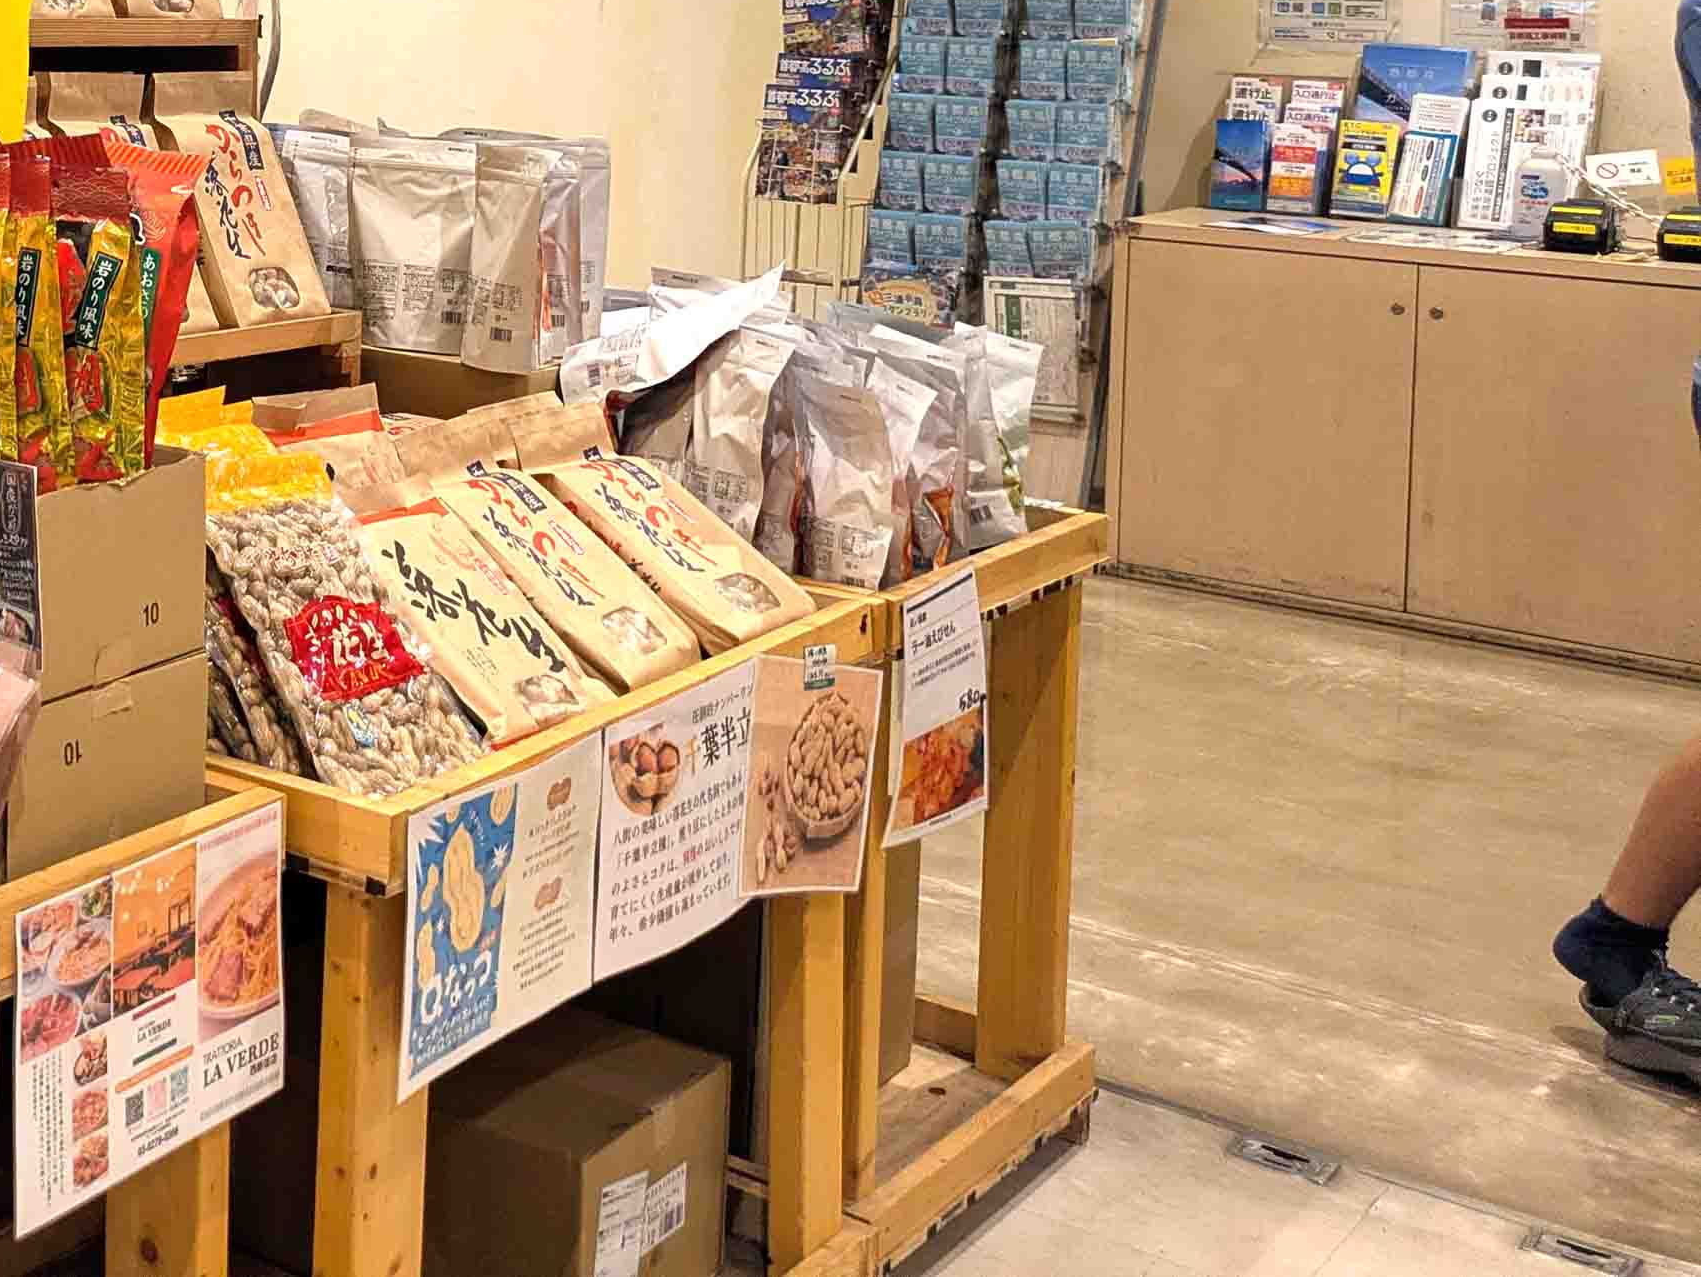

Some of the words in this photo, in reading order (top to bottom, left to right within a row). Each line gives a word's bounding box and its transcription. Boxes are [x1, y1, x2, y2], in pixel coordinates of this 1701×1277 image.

[80, 259, 114, 344] 岩のり風味
[142, 601, 160, 628] 10
[381, 539, 566, 673] 落花生
[203, 1063, 224, 1090] LA
[227, 1031, 279, 1075] VERDE
